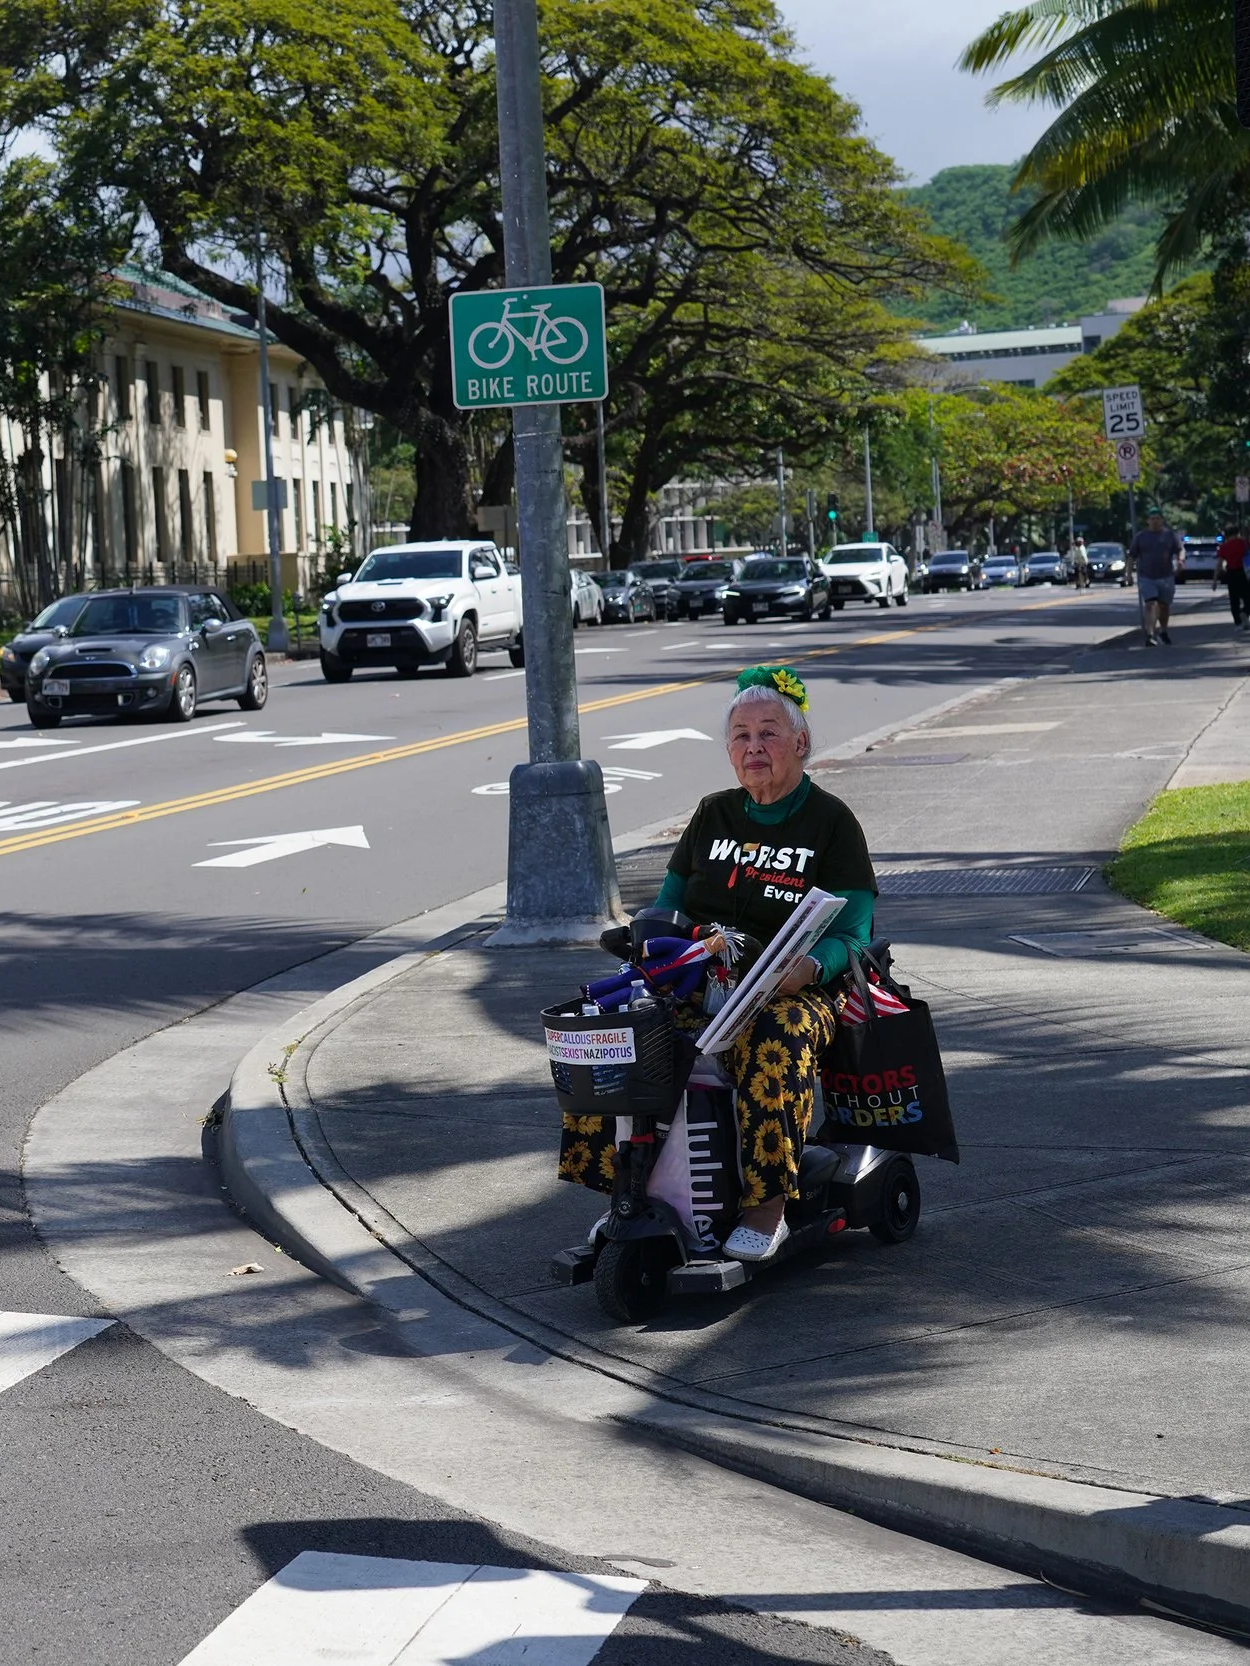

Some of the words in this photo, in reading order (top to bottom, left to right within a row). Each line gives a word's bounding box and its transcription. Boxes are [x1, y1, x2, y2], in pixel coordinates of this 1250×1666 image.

[468, 377, 514, 400] BIKE
[526, 371, 593, 397] ROUTE
[1106, 391, 1138, 402] SPEED
[1110, 402, 1135, 412] LIMIT
[1110, 413, 1140, 433] 25
[709, 839, 815, 873] WORST
[744, 866, 805, 888] President
[763, 885, 803, 903] Ever
[547, 1030, 627, 1045] SUPERCALLOUSFRAGILE
[549, 1045, 632, 1059] ACISTSEXISTNAZIPOTUS
[820, 1065, 917, 1095] OCTORS
[824, 1085, 919, 1108] THOUT
[825, 1101, 923, 1127] ORDERS
